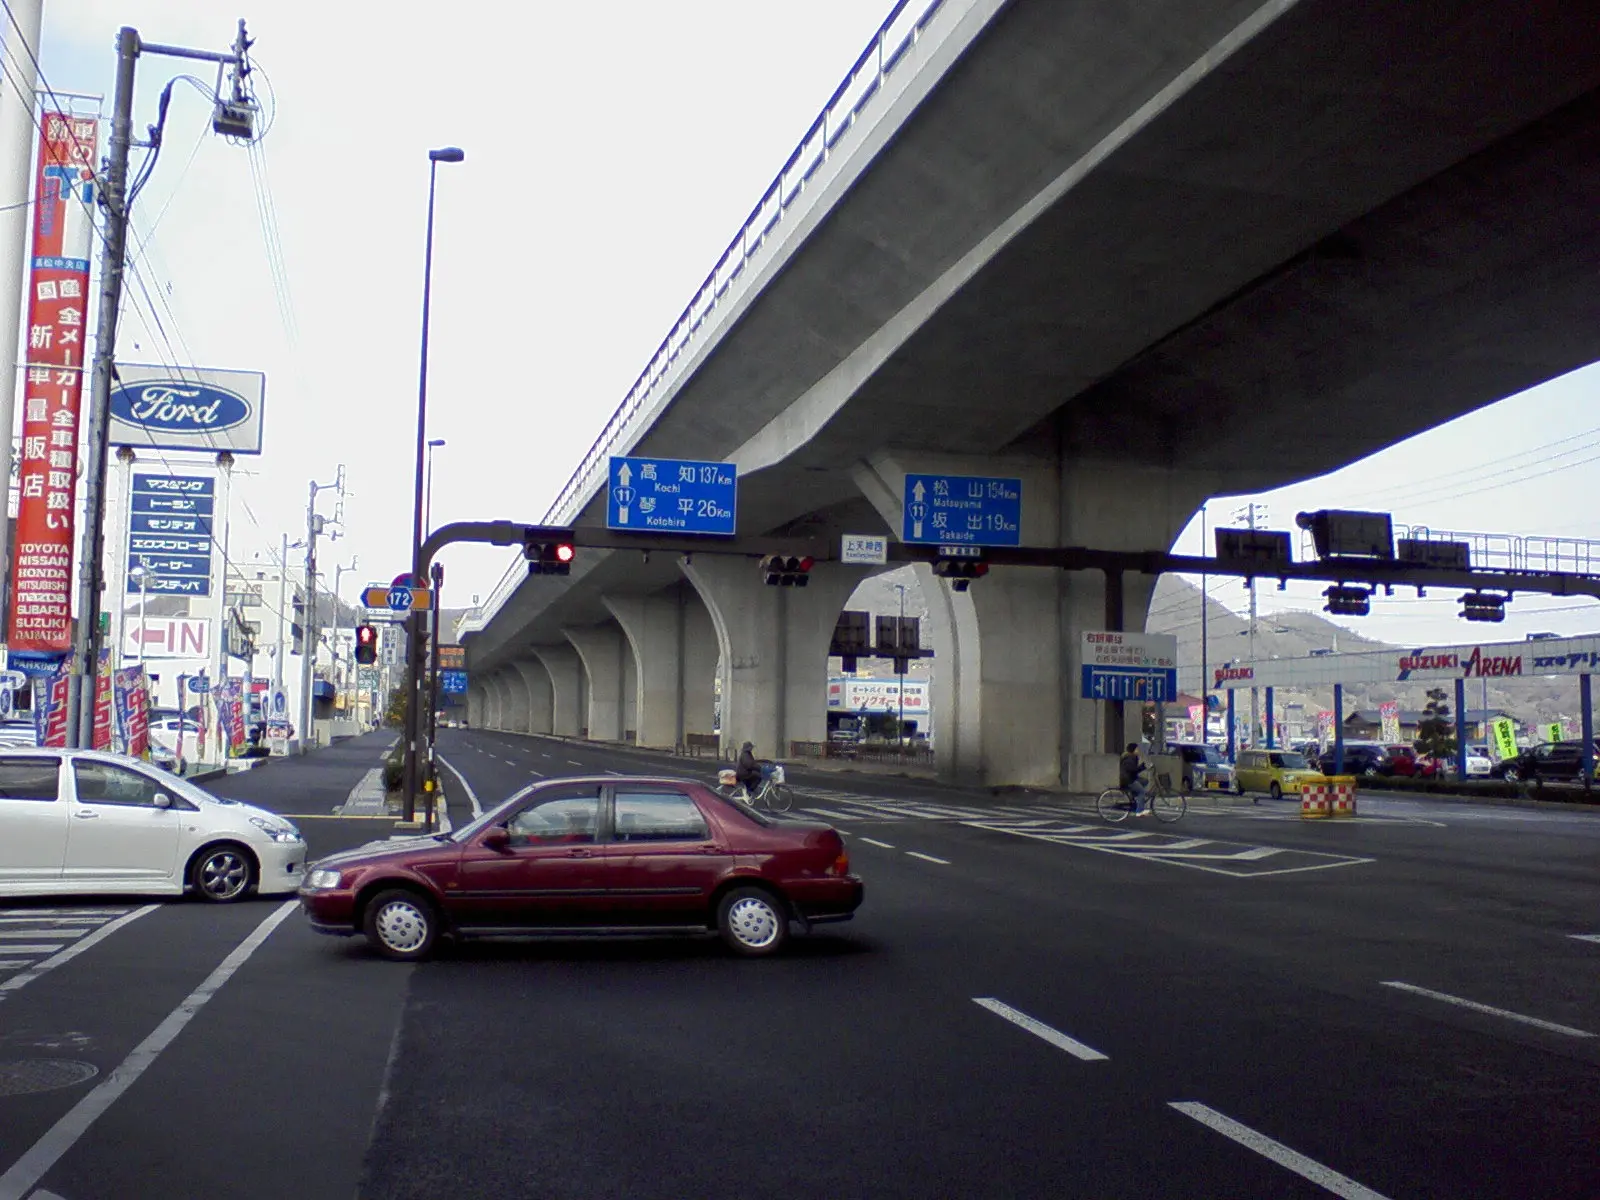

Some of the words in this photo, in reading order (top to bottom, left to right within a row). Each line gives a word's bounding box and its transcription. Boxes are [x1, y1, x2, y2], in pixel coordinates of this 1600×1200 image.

[131, 386, 221, 424] Ford
[640, 463, 695, 483] 高知
[654, 483, 681, 493] Kochi
[933, 480, 983, 498] 松山
[618, 490, 630, 501] 11
[912, 505, 924, 517] 11
[931, 512, 982, 530] 坂出
[19, 543, 69, 554] TOYOTA
[18, 556, 68, 566] NISSAN
[17, 568, 67, 579] HONDA
[389, 592, 410, 606] 172
[16, 604, 67, 615] SUBARU
[15, 617, 66, 629] SUZUKI
[167, 622, 204, 654] IN
[1399, 654, 1459, 671] SUZUKI
[1461, 646, 1523, 677] ARENA
